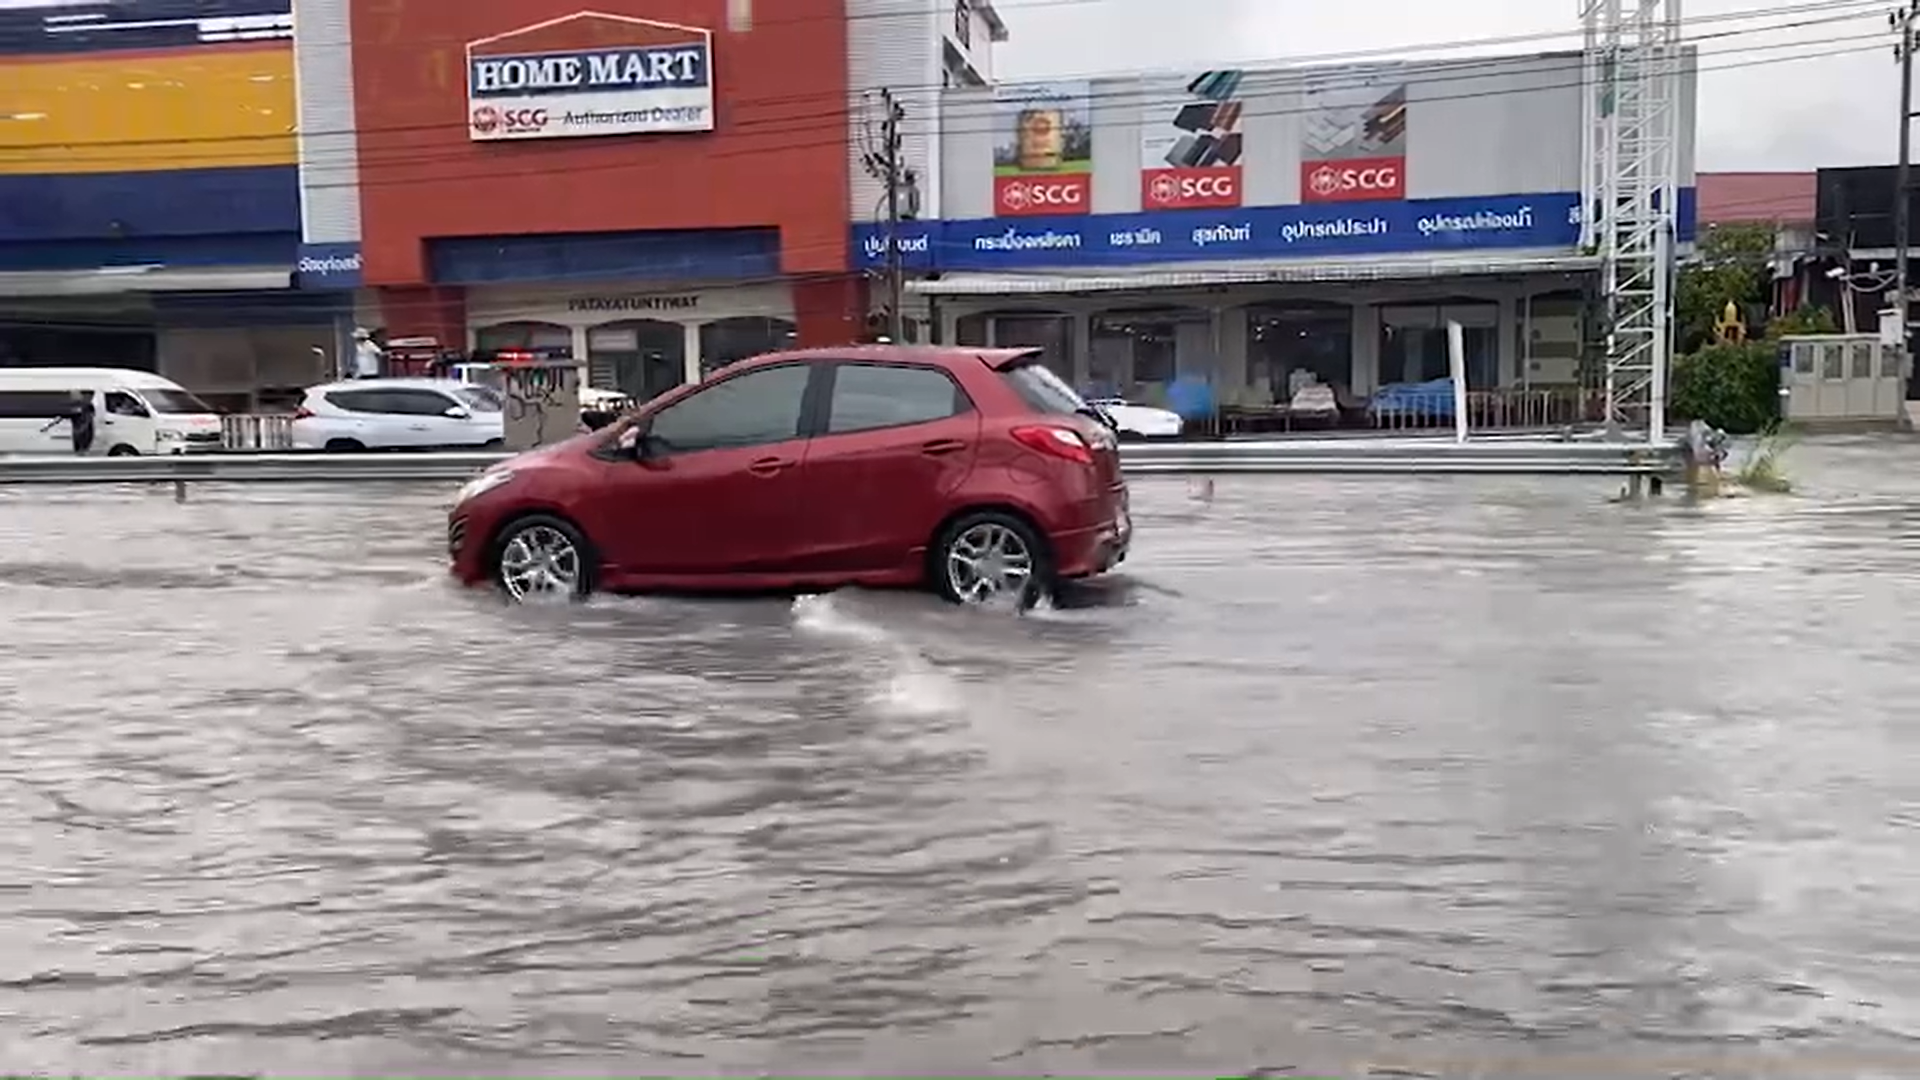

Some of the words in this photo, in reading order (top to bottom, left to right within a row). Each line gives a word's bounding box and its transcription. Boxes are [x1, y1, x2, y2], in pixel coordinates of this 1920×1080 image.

[475, 57, 582, 90] HOME
[588, 51, 699, 84] MART
[504, 109, 549, 127] SCG
[563, 107, 648, 126] Authorized
[653, 105, 703, 123] Dealer
[1180, 175, 1233, 197] SCG
[1342, 168, 1396, 190] SCG
[1031, 184, 1081, 205] SCG
